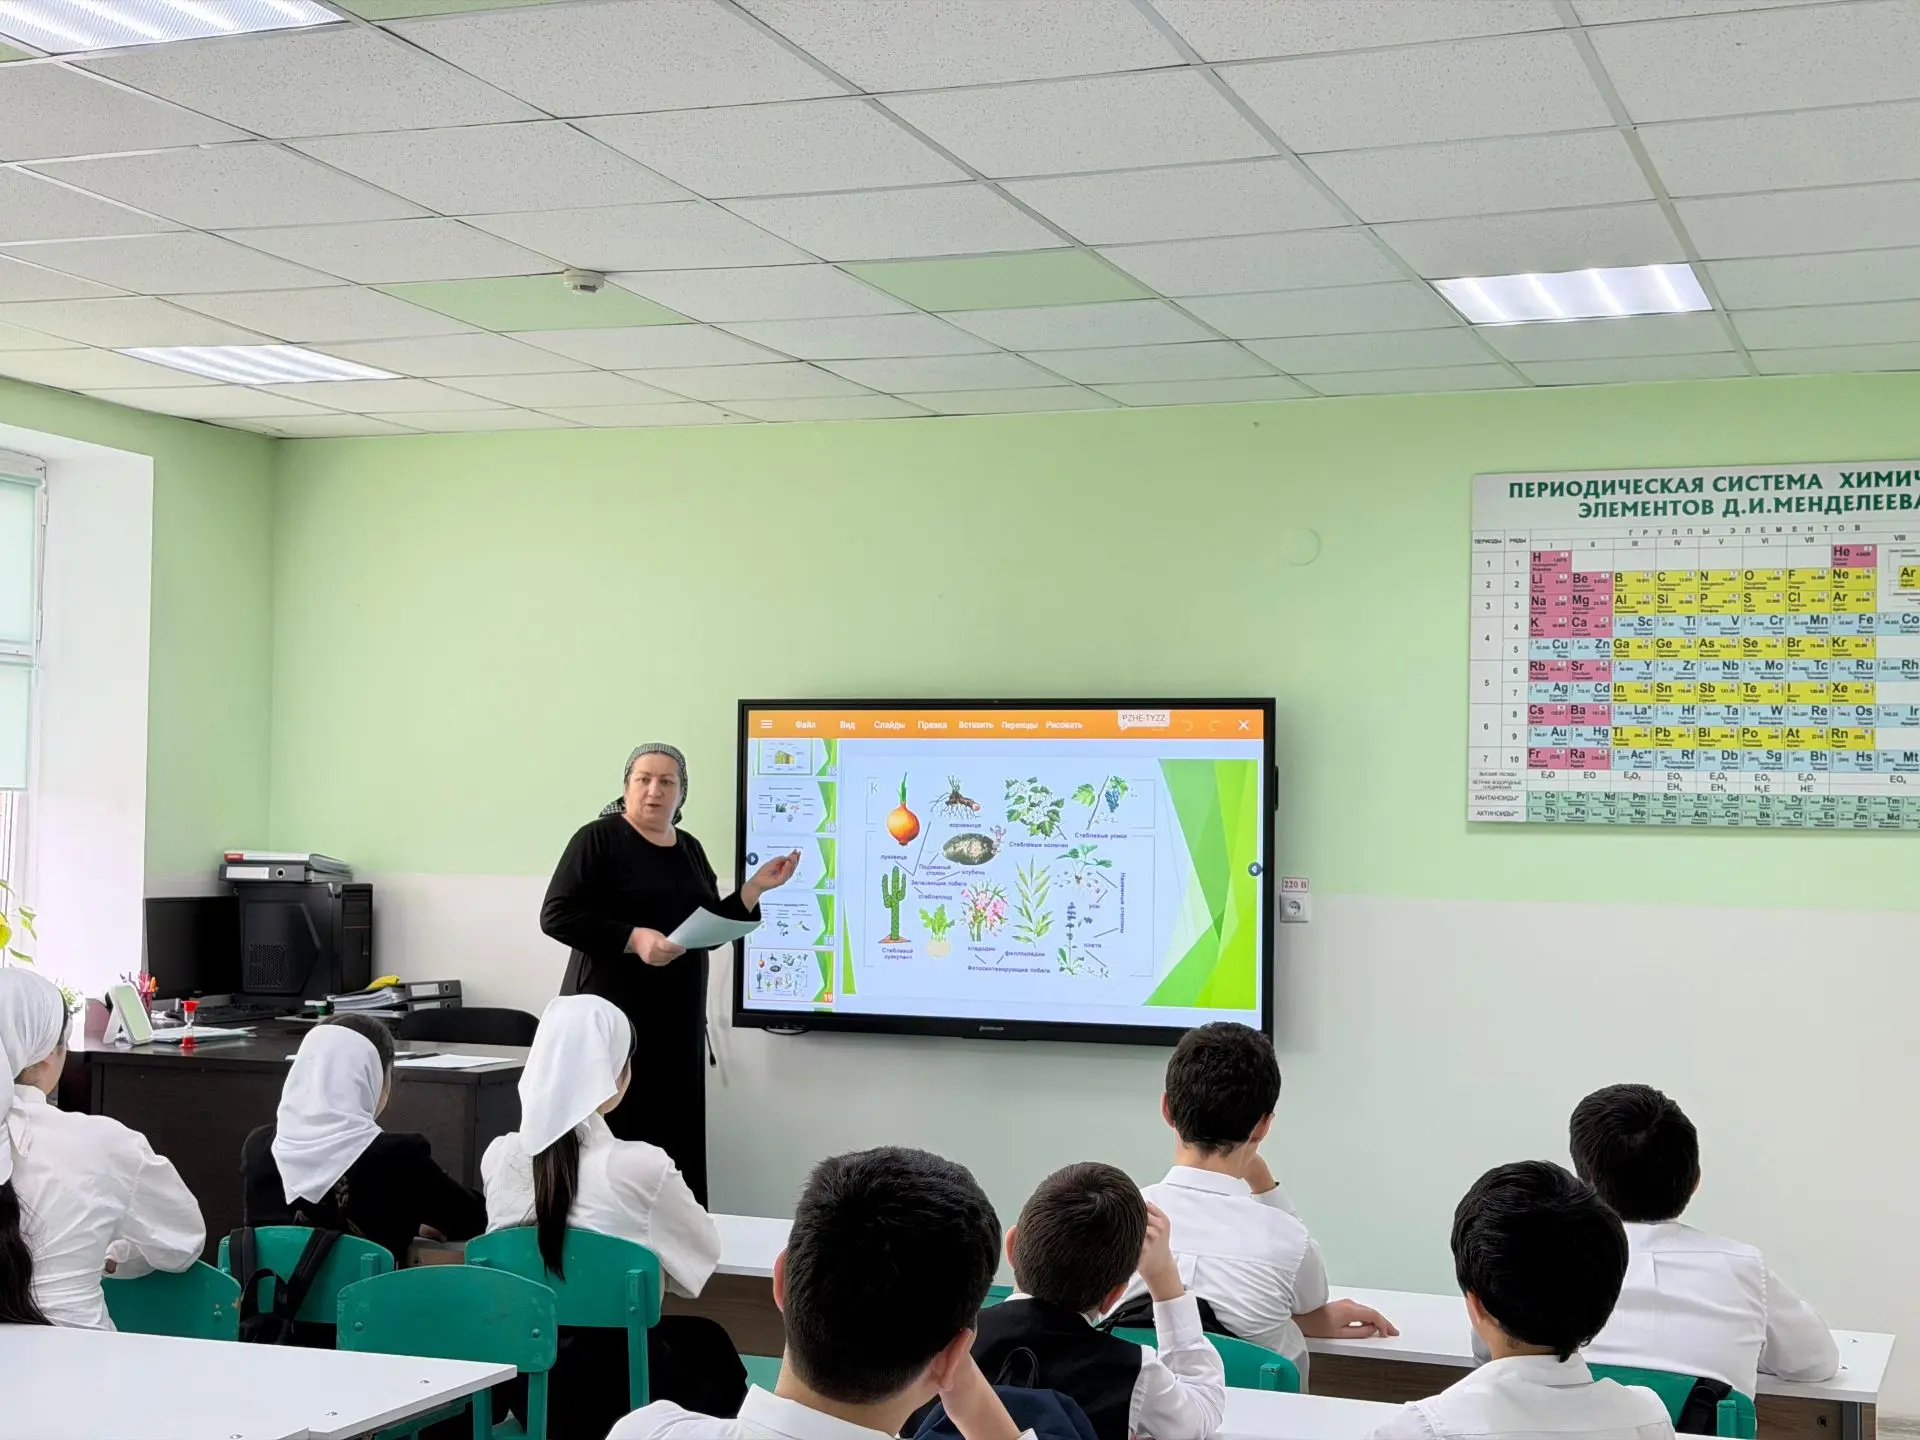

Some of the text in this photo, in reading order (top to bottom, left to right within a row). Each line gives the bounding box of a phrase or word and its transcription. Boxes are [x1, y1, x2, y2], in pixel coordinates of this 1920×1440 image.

[1509, 477, 1703, 499] ПЕРИОДИЧЕСКАЯ
[1712, 473, 1823, 492] СИСТЕМА
[1578, 499, 1714, 518] ЭЛЕМЕНТОВ
[1834, 546, 1850, 557] He
[1533, 552, 1541, 562] H
[1573, 573, 1588, 583] Be
[1615, 573, 1623, 582] B
[1658, 572, 1666, 582] C
[1700, 571, 1709, 581] N
[1744, 571, 1754, 581] O
[1789, 570, 1795, 580] F
[1833, 569, 1849, 580] Ne
[1901, 568, 1916, 578] Ar
[1532, 573, 1542, 584] Li
[1531, 596, 1546, 606] Na
[1572, 595, 1590, 607] Mg
[1614, 595, 1627, 604] Al
[1657, 594, 1668, 604] Si
[1700, 594, 1708, 604] P
[1744, 593, 1752, 603] S
[1788, 592, 1800, 602] Cl
[1833, 592, 1848, 602] Ar
[1485, 602, 1491, 610] 3
[1530, 617, 1539, 627] K
[1572, 617, 1587, 627] Ca
[1637, 616, 1653, 626] Sc
[1686, 616, 1696, 626] Ti
[1731, 616, 1740, 626] V
[1769, 615, 1784, 626] Cr
[1810, 615, 1829, 625] Mn
[1858, 614, 1874, 625] Fe
[1902, 614, 1920, 624] Co
[1485, 634, 1490, 642] 4
[1743, 638, 1758, 648] Se
[1787, 638, 1802, 648] Br
[1832, 637, 1847, 647] Kr
[1552, 639, 1568, 649] Cu
[1595, 639, 1610, 649] Zn
[1614, 639, 1630, 649] Ga
[1656, 639, 1672, 649] Ge
[1699, 638, 1715, 649] As
[1530, 661, 1546, 671] Rb
[1571, 661, 1584, 671] Sr
[1644, 661, 1652, 671] Y
[1683, 661, 1696, 671] Zr
[1723, 660, 1739, 671] Nb
[1765, 660, 1783, 671] Mo
[1814, 660, 1828, 670] Tc
[1856, 660, 1873, 670] Ru
[1901, 660, 1919, 670] Rh
[1513, 667, 1518, 675] 6
[1485, 679, 1489, 687] 5
[1594, 683, 1610, 693] Cd
[1656, 683, 1672, 693] Sn
[1700, 683, 1715, 693] Sb
[1743, 683, 1757, 693] Te
[1832, 683, 1848, 693] Xe
[1553, 683, 1569, 694] Ag
[1614, 684, 1624, 693] In
[1529, 705, 1544, 715] Cs
[1571, 705, 1585, 715] Ba
[1682, 705, 1695, 715] Hf
[1724, 705, 1739, 716] Ta
[1771, 705, 1783, 716] W
[1811, 705, 1828, 716] Re
[1855, 705, 1873, 716] Os
[1910, 705, 1919, 715] Ir
[1122, 714, 1166, 722] PZHE-TYZZ
[795, 720, 816, 729] Файл
[840, 721, 855, 730] Вид
[874, 721, 906, 731] Слайды
[917, 721, 947, 731] Правка
[959, 721, 994, 729] Вставить
[1001, 721, 1038, 730] Переходы
[1046, 721, 1083, 729] Рисовать
[1551, 727, 1567, 737] Au
[1593, 727, 1609, 739] Hg
[1613, 727, 1623, 737] Tl
[1655, 727, 1671, 737] Pb
[1699, 728, 1711, 738] Bi
[1742, 728, 1758, 738] Po
[1786, 728, 1800, 738] At
[1831, 728, 1848, 739] Rn
[1529, 749, 1540, 759] Fr
[1570, 749, 1585, 759] Ra
[1682, 750, 1695, 760] Rf
[1721, 750, 1738, 761] Db
[1766, 751, 1782, 762] Sg
[1810, 751, 1827, 761] Bh
[1856, 751, 1872, 762] Hs
[1903, 752, 1919, 762] Mt
[1284, 880, 1298, 888] 220
